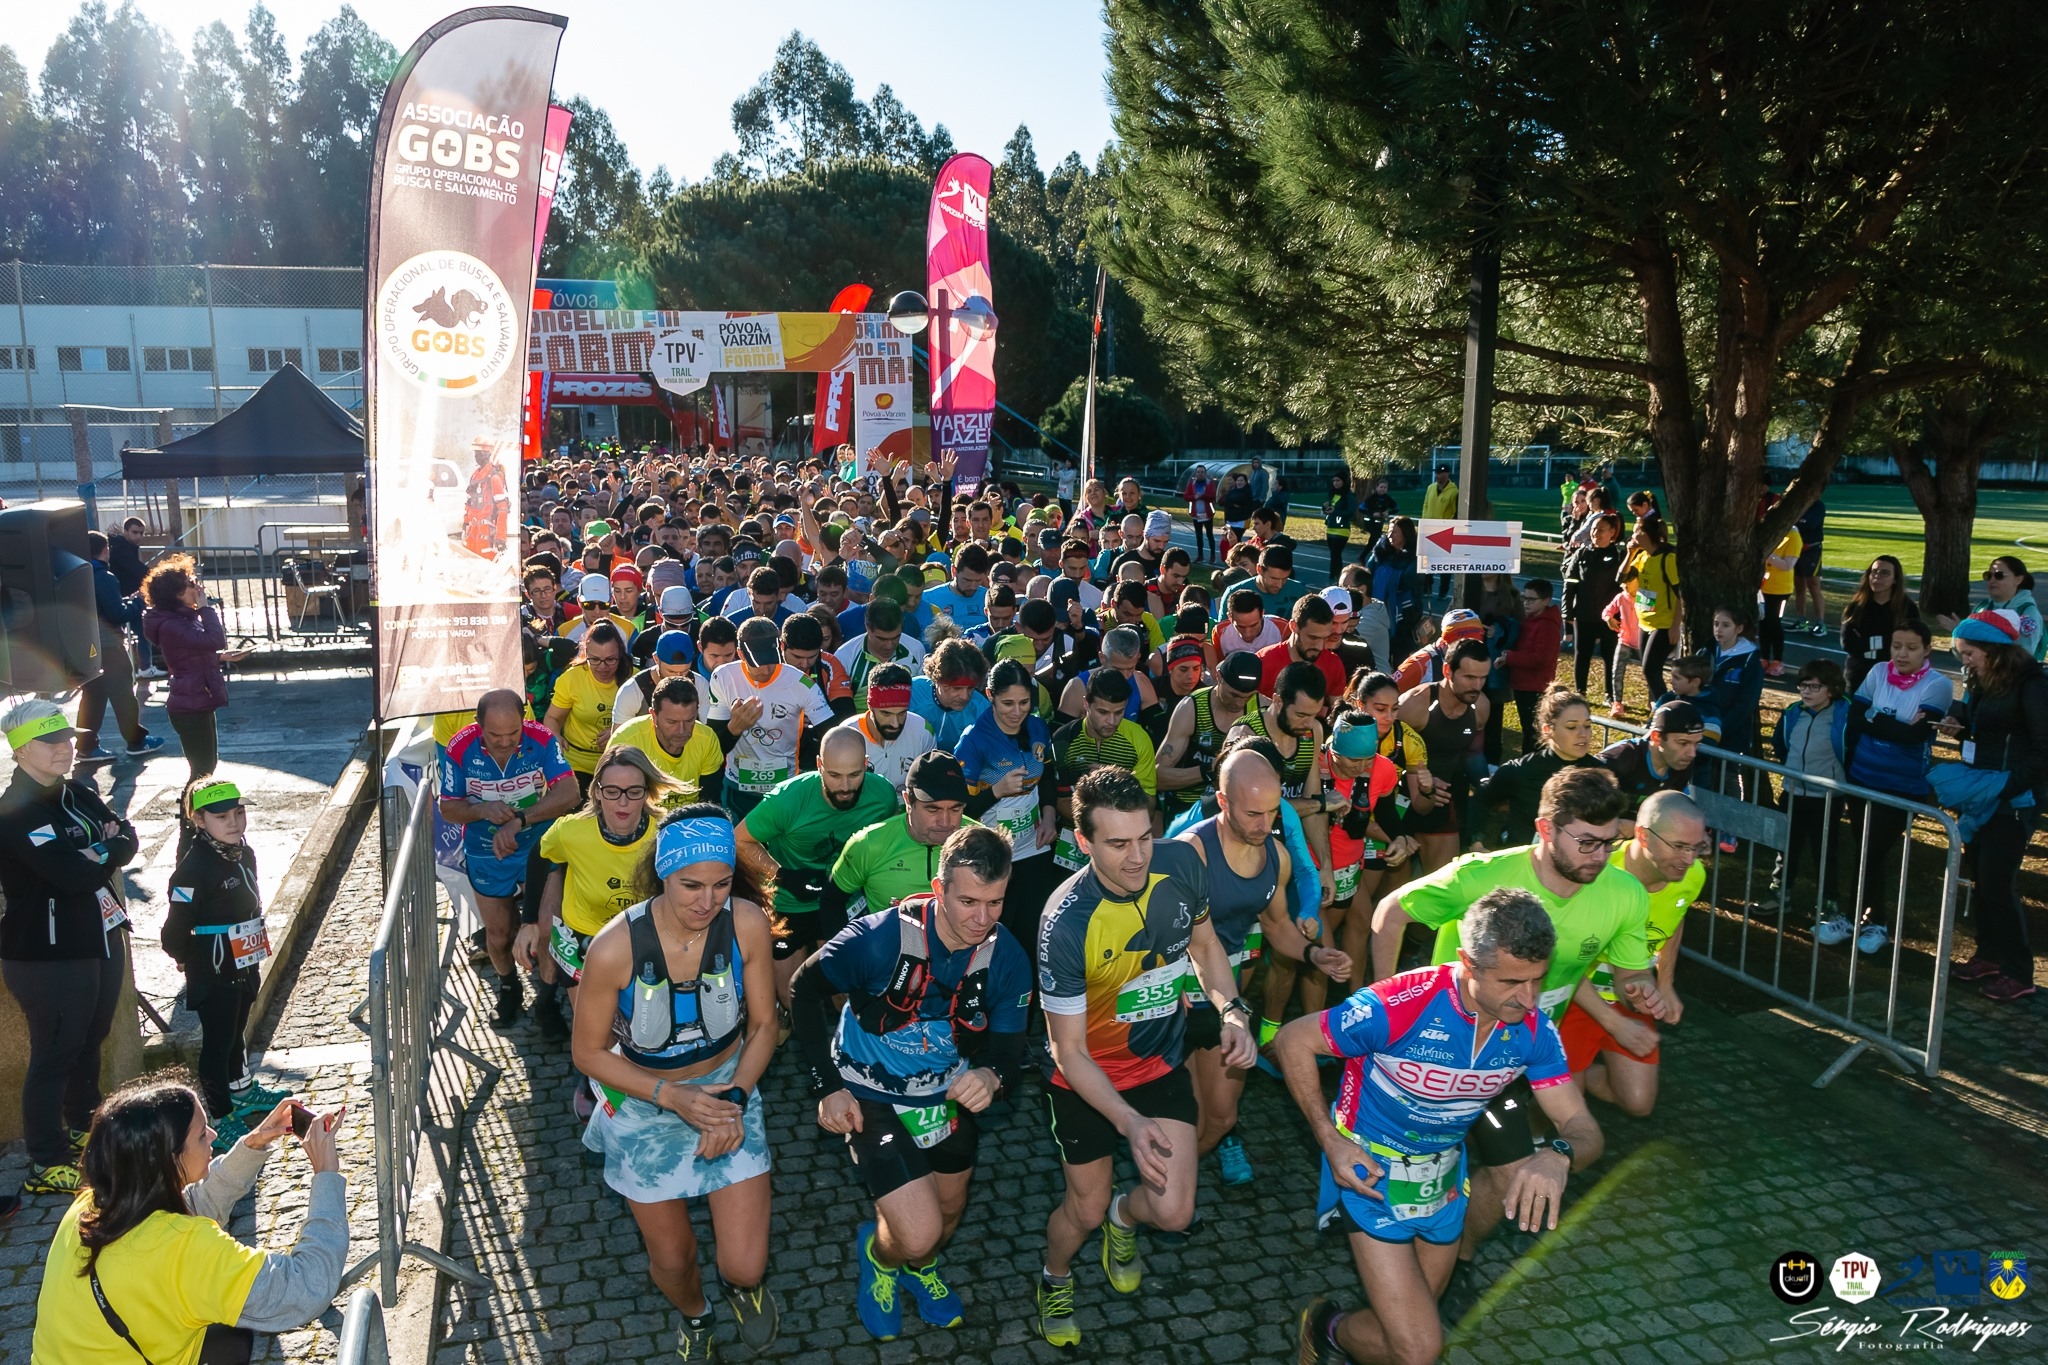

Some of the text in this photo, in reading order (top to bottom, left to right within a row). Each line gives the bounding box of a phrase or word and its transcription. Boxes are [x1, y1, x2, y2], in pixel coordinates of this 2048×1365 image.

[402, 102, 525, 140] ASSOCIAÇÃO
[397, 124, 521, 179] GOBS
[395, 163, 518, 194] GRUPO OPERACIONAL DE
[393, 175, 517, 205] BUSCA E SALVAMENTO
[553, 288, 599, 309] óvoa
[384, 259, 511, 380] GRUPO OPERACIONAL DE BUSCA E SALVAMENTO
[532, 310, 636, 333] ONCELHO
[719, 320, 763, 335] PÓVOA
[411, 329, 486, 358] GOBS
[720, 333, 772, 347] VARZIM
[664, 342, 696, 364] TPV
[725, 352, 780, 369] FORMA!
[671, 367, 692, 377] TRAIL
[862, 410, 907, 418] Póvoa Varzim
[453, 616, 469, 626] 913
[450, 629, 476, 638] VARZIM
[750, 770, 776, 781] 269
[1011, 812, 1032, 829] 353
[1339, 877, 1354, 889] 45
[1040, 891, 1079, 962] BARCELOS
[240, 932, 267, 950] 2071
[1136, 980, 1174, 1004] 355
[1419, 1028, 1450, 1042] KTM
[1396, 1061, 1517, 1093] SEISSA
[1420, 1177, 1443, 1198] 61
